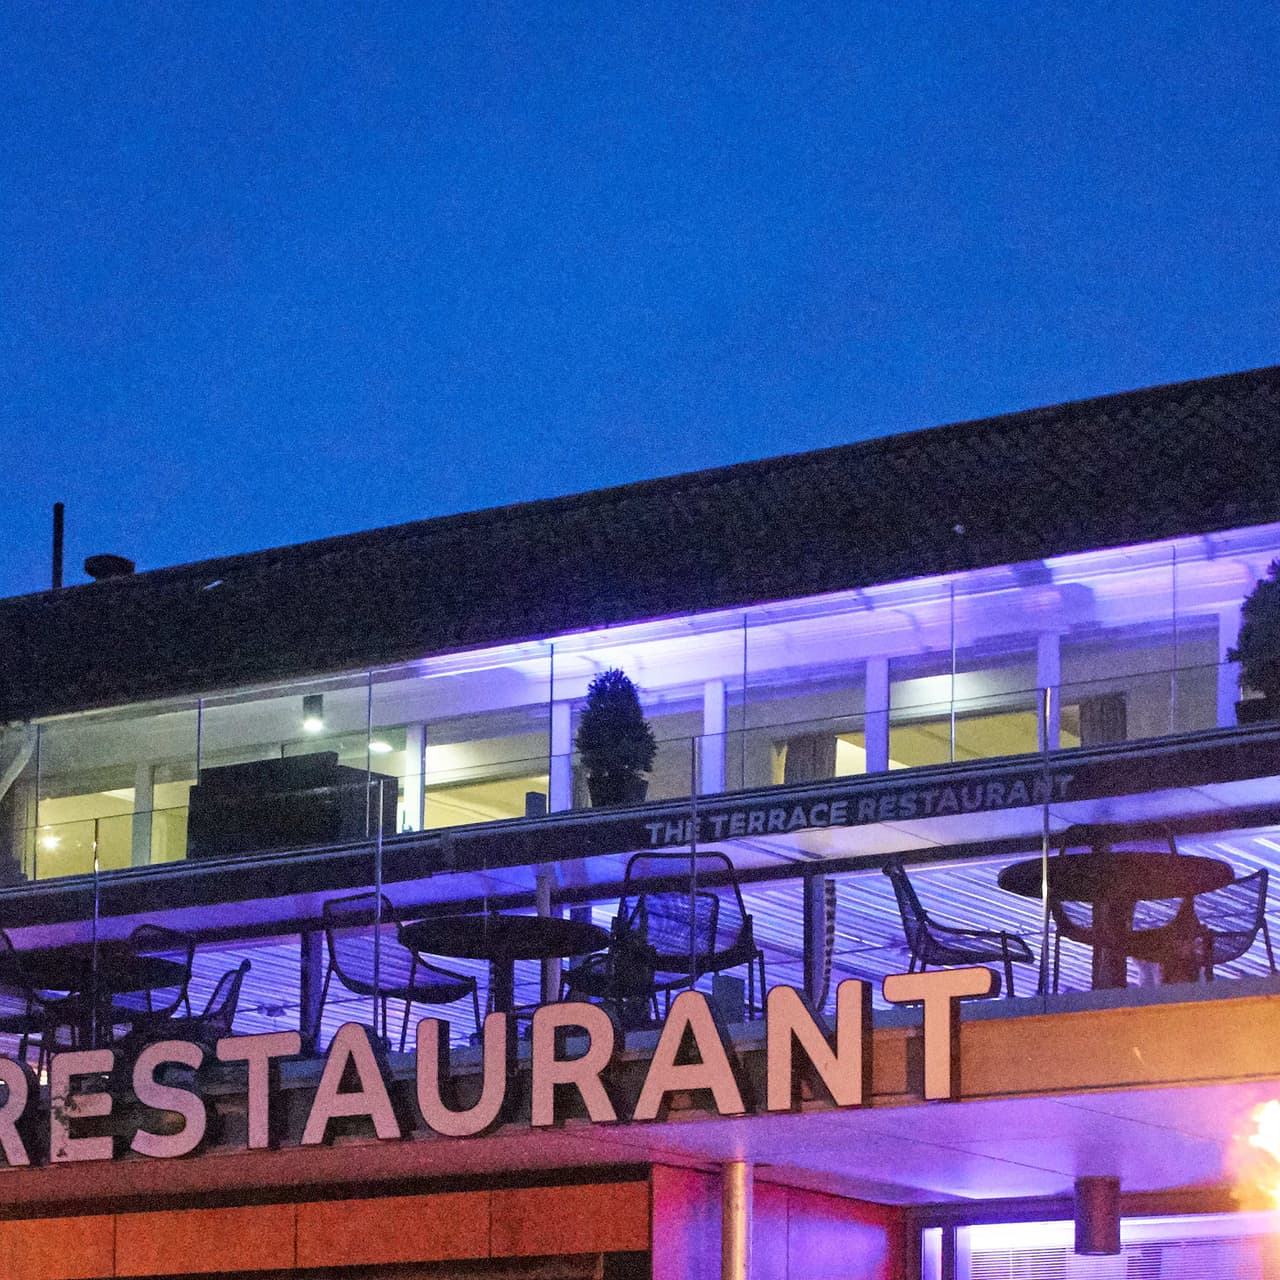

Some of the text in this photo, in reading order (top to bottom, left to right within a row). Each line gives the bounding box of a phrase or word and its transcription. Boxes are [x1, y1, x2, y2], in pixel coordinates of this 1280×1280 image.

[646, 775, 1074, 844] THE TERRACE RESTAURANT
